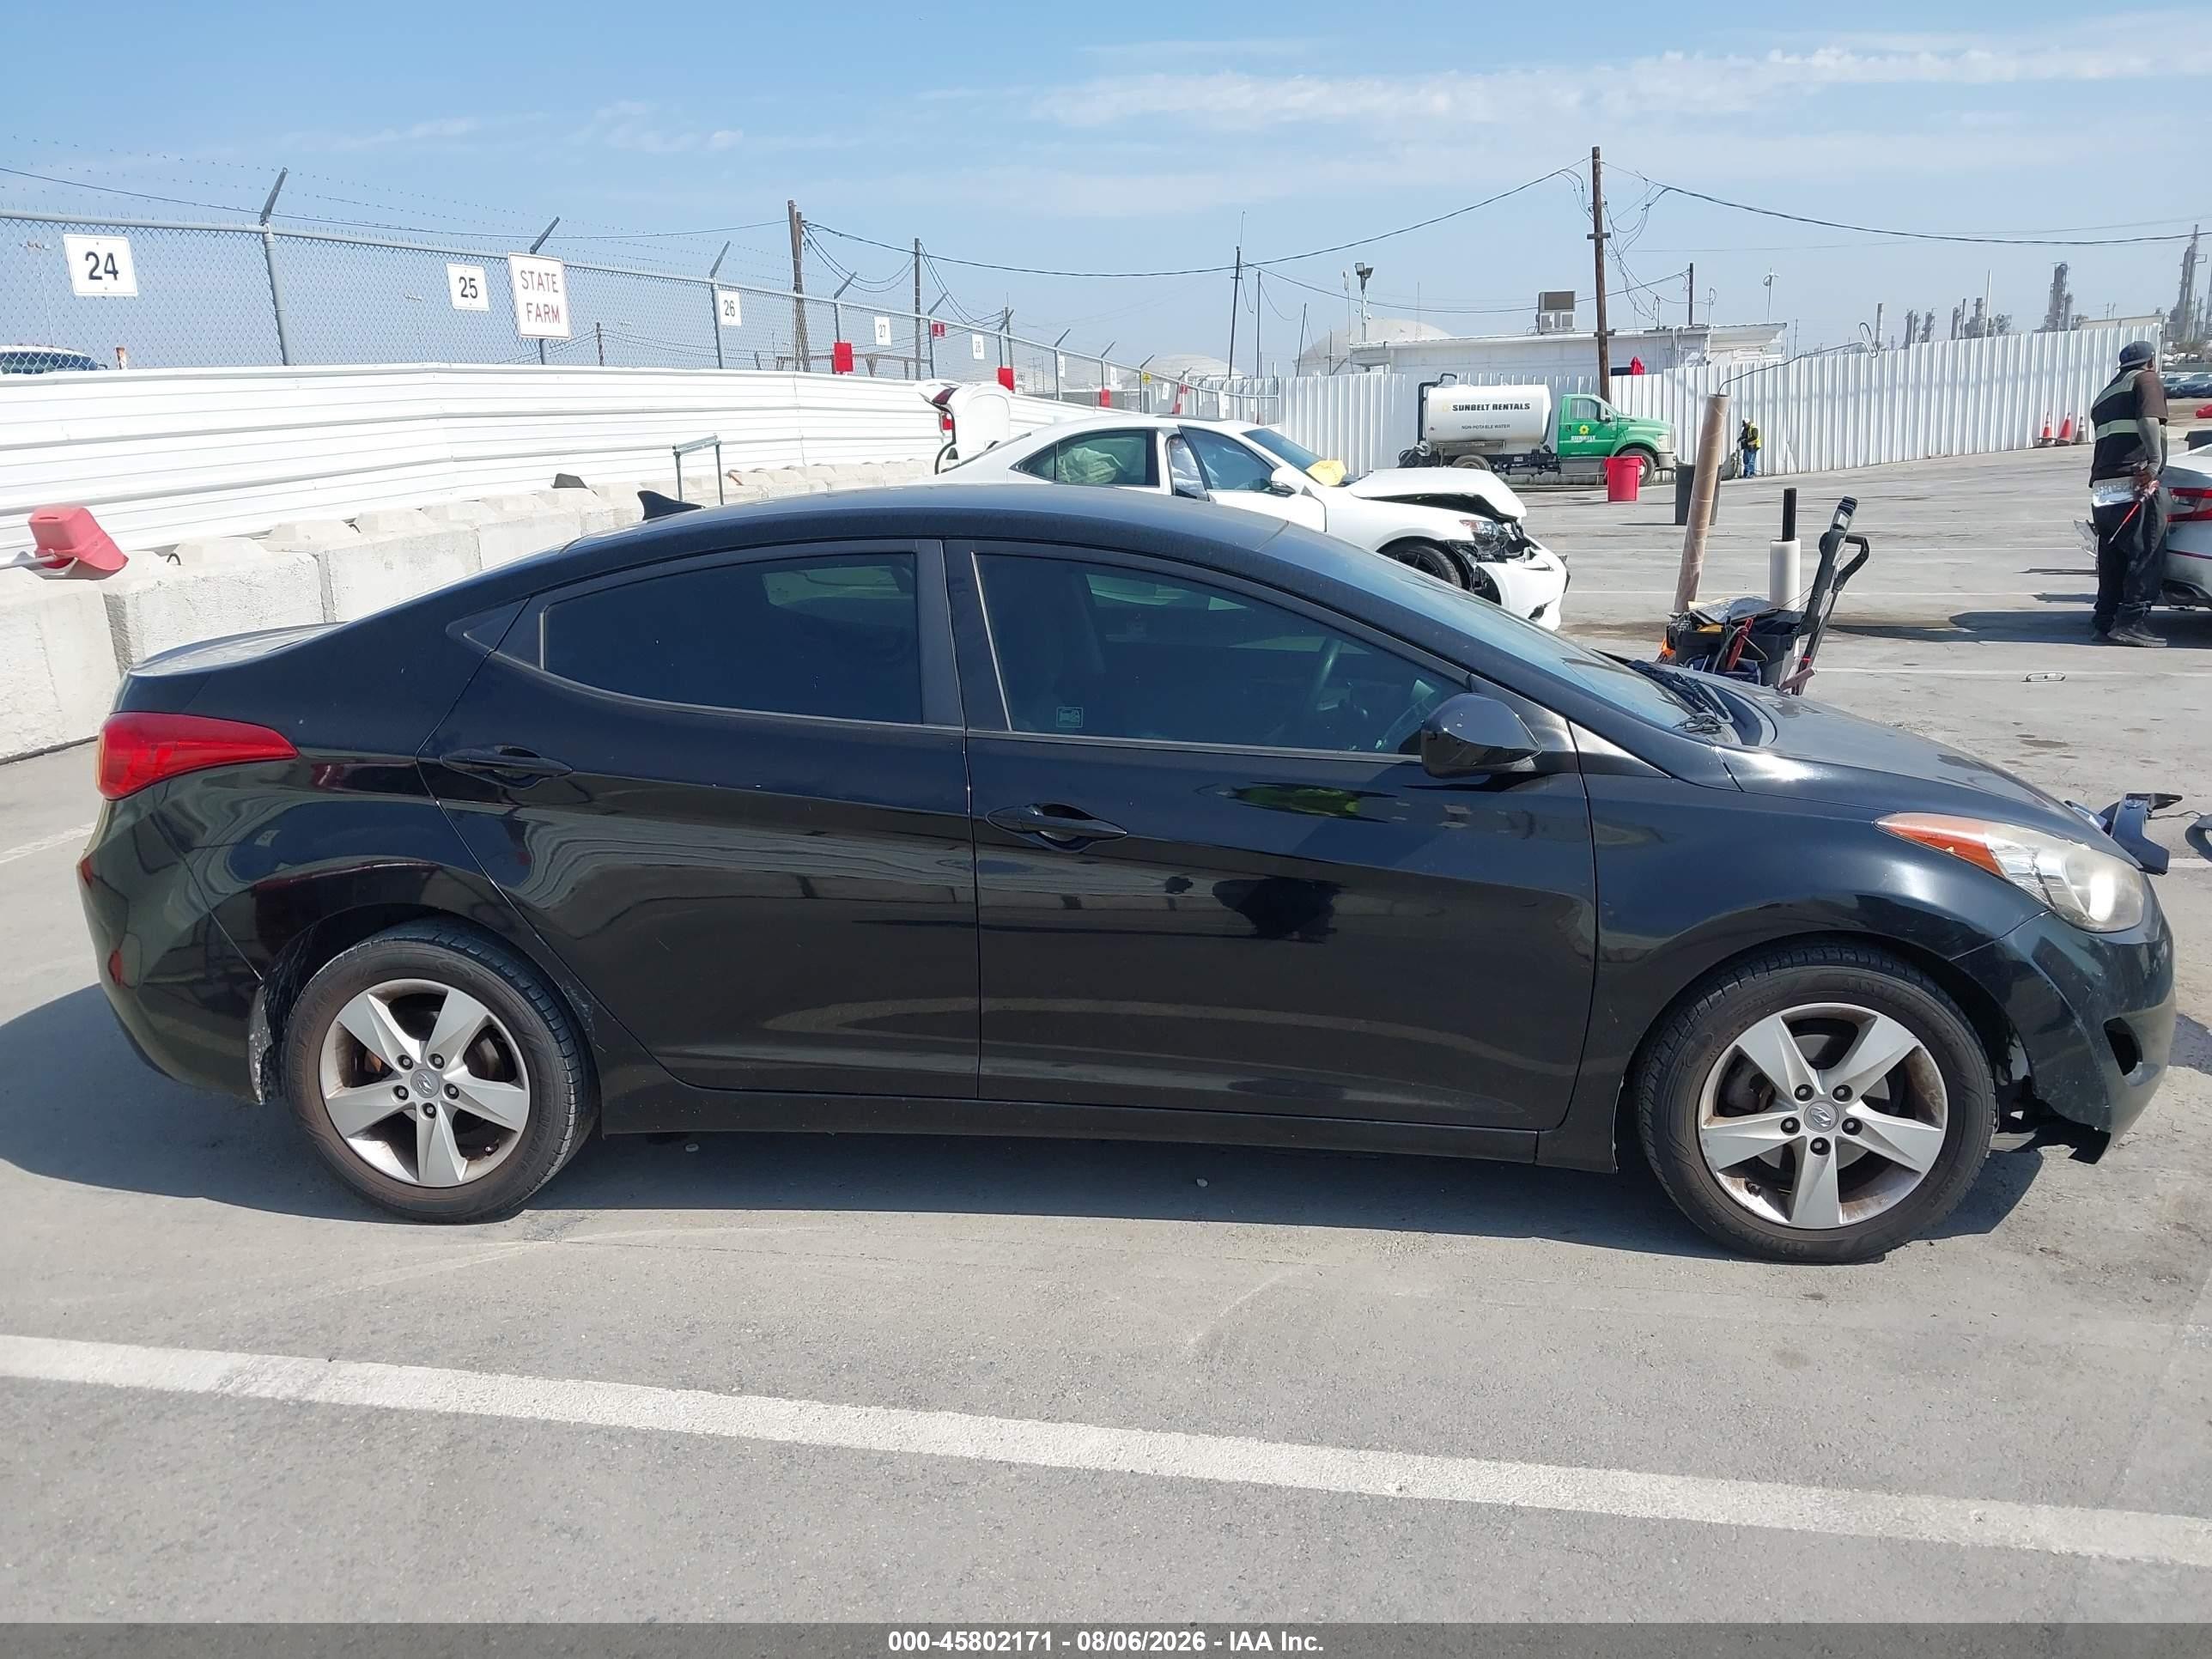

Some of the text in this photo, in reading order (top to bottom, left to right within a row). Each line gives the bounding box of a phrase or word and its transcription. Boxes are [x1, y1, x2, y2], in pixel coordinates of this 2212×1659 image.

[85, 251, 118, 281] 24
[459, 276, 478, 299] 25
[520, 270, 559, 294] STATE
[526, 302, 561, 324] FARM
[723, 299, 736, 318] 26
[878, 324, 886, 338] 27
[1452, 404, 1491, 412] SUNBELT
